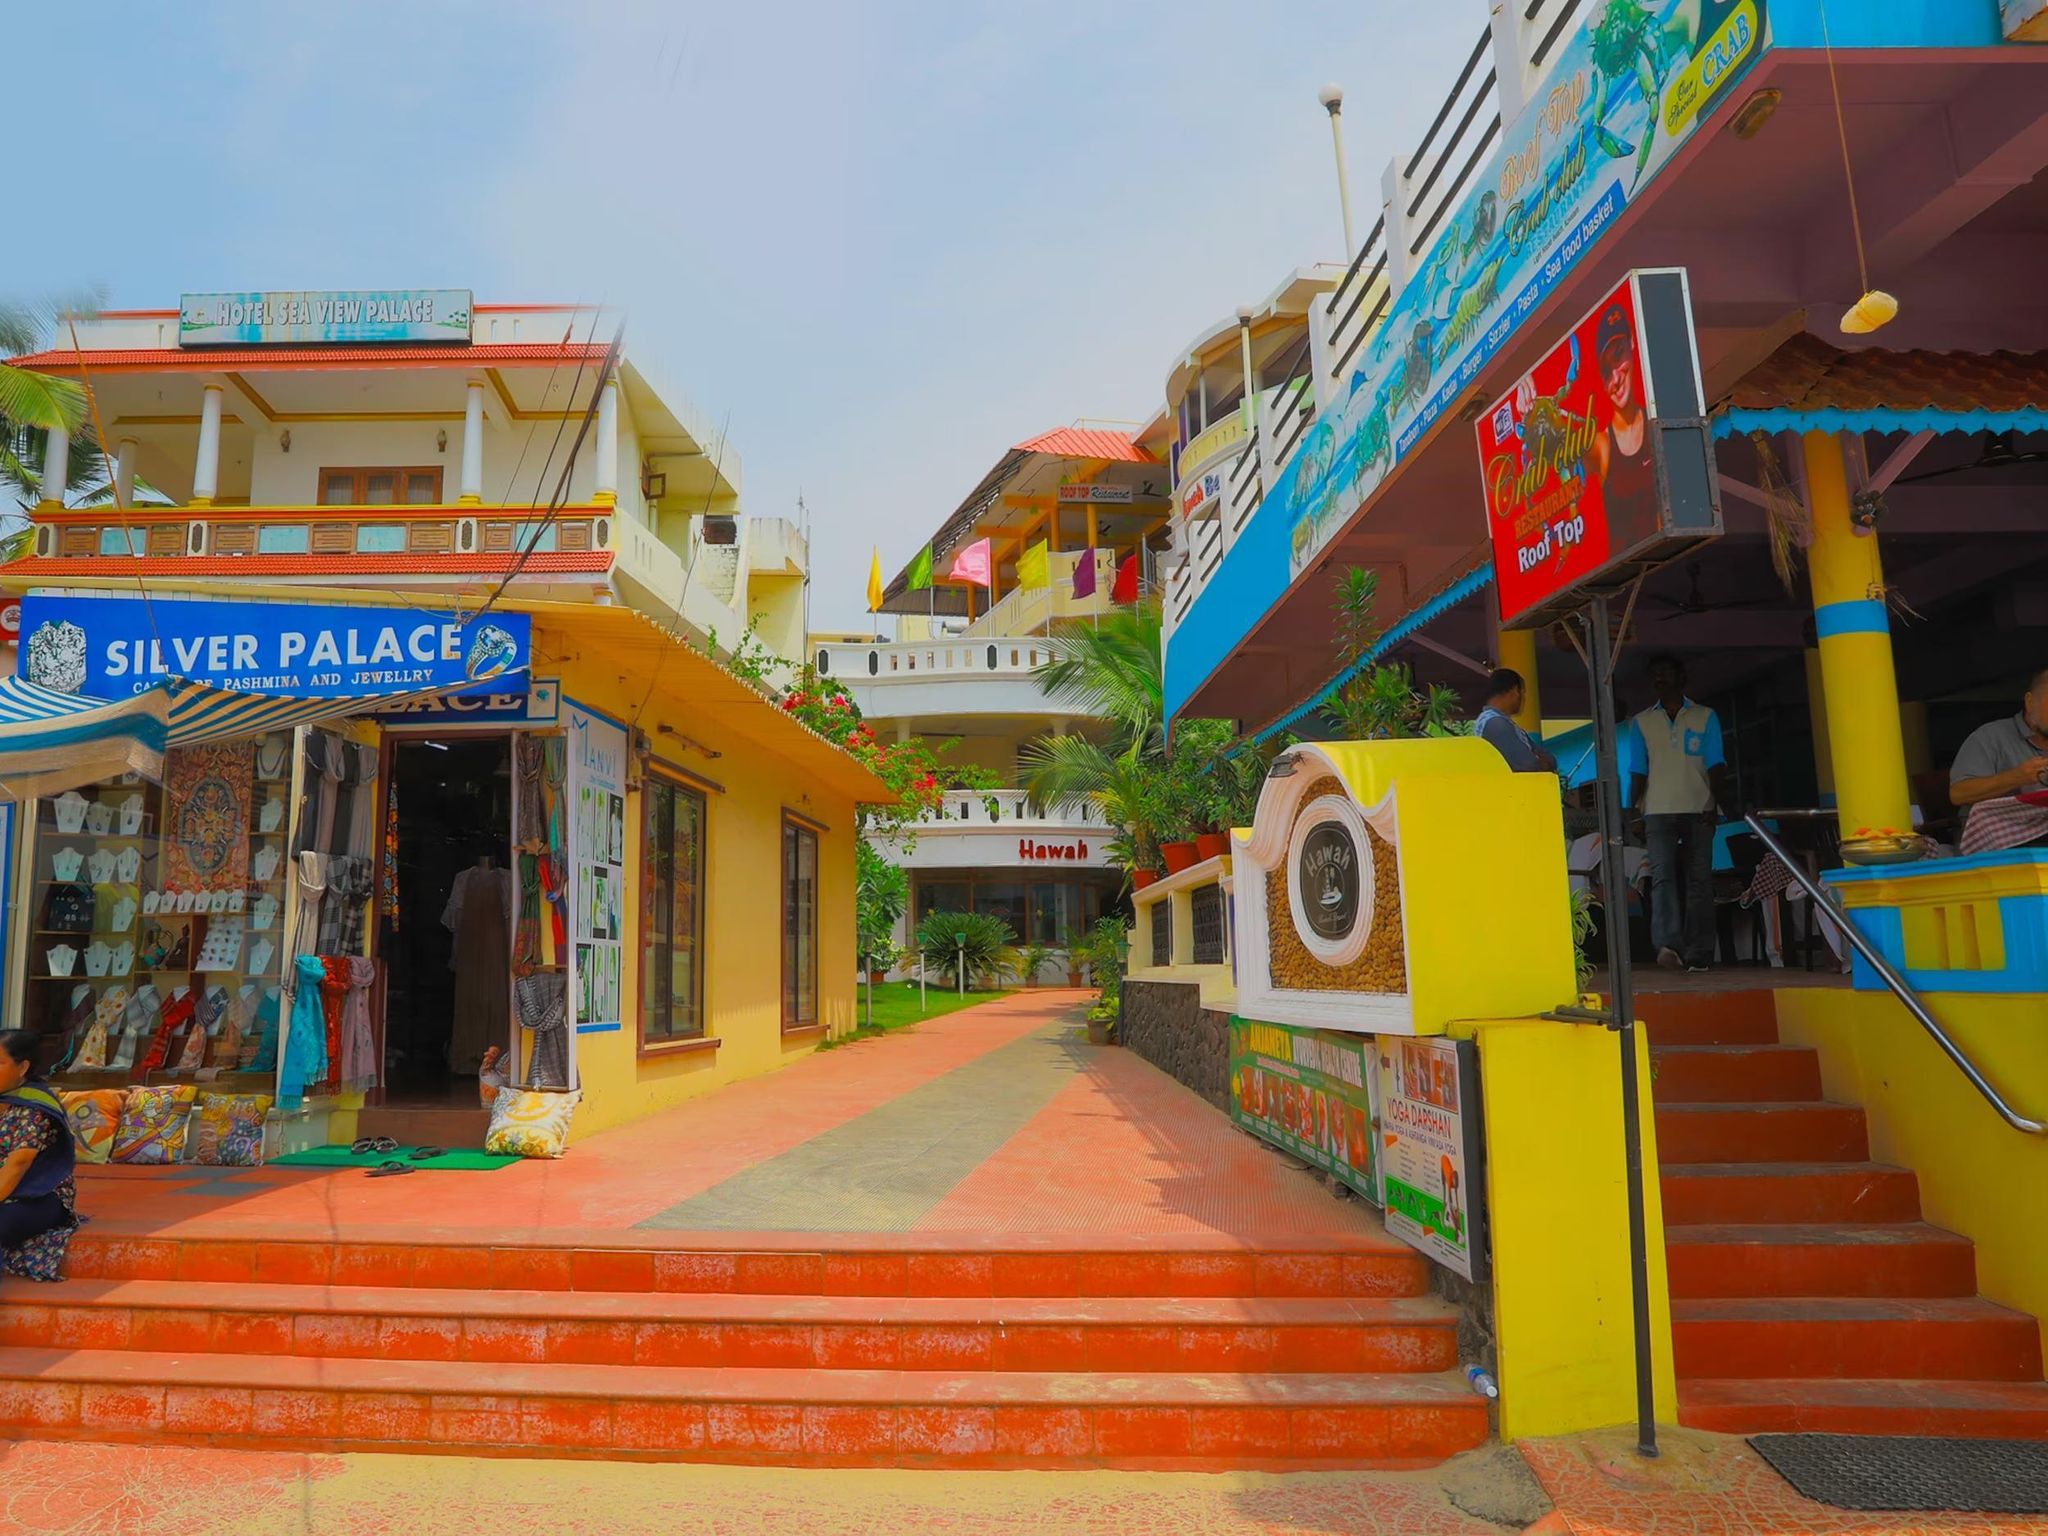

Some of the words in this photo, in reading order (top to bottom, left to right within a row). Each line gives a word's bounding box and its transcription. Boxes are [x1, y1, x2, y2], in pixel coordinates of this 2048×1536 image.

[1702, 13, 1751, 88] CRAB
[1504, 172, 1550, 257] Crab
[1554, 125, 1586, 203] club
[216, 301, 274, 327] HOTEL
[277, 300, 312, 326] SEA
[314, 299, 362, 325] VIEW
[365, 298, 434, 324] PALACE
[1462, 347, 1483, 380] Burger
[1488, 315, 1511, 350] Sizzler
[1517, 283, 1539, 317] Pasta
[1545, 257, 1562, 284] Sea
[1562, 228, 1582, 266] food
[1582, 192, 1614, 243] basket
[1487, 434, 1548, 518] Crab
[1554, 394, 1596, 474] club
[1060, 485, 1077, 499] ROOF
[1078, 485, 1090, 499] TOP
[1518, 527, 1552, 573] Roof
[1553, 514, 1585, 549] Top
[104, 634, 259, 676] SILVER
[279, 623, 462, 668] PALACE
[223, 675, 300, 690] PASHMINA
[310, 672, 342, 686] AND
[351, 669, 434, 685] JEWELLRY
[572, 713, 616, 779] MANVI
[1018, 838, 1089, 860] Hawah
[1305, 844, 1351, 877] Hawah
[1386, 1096, 1410, 1126] YOGA
[1411, 1104, 1453, 1140] DARSHAN
